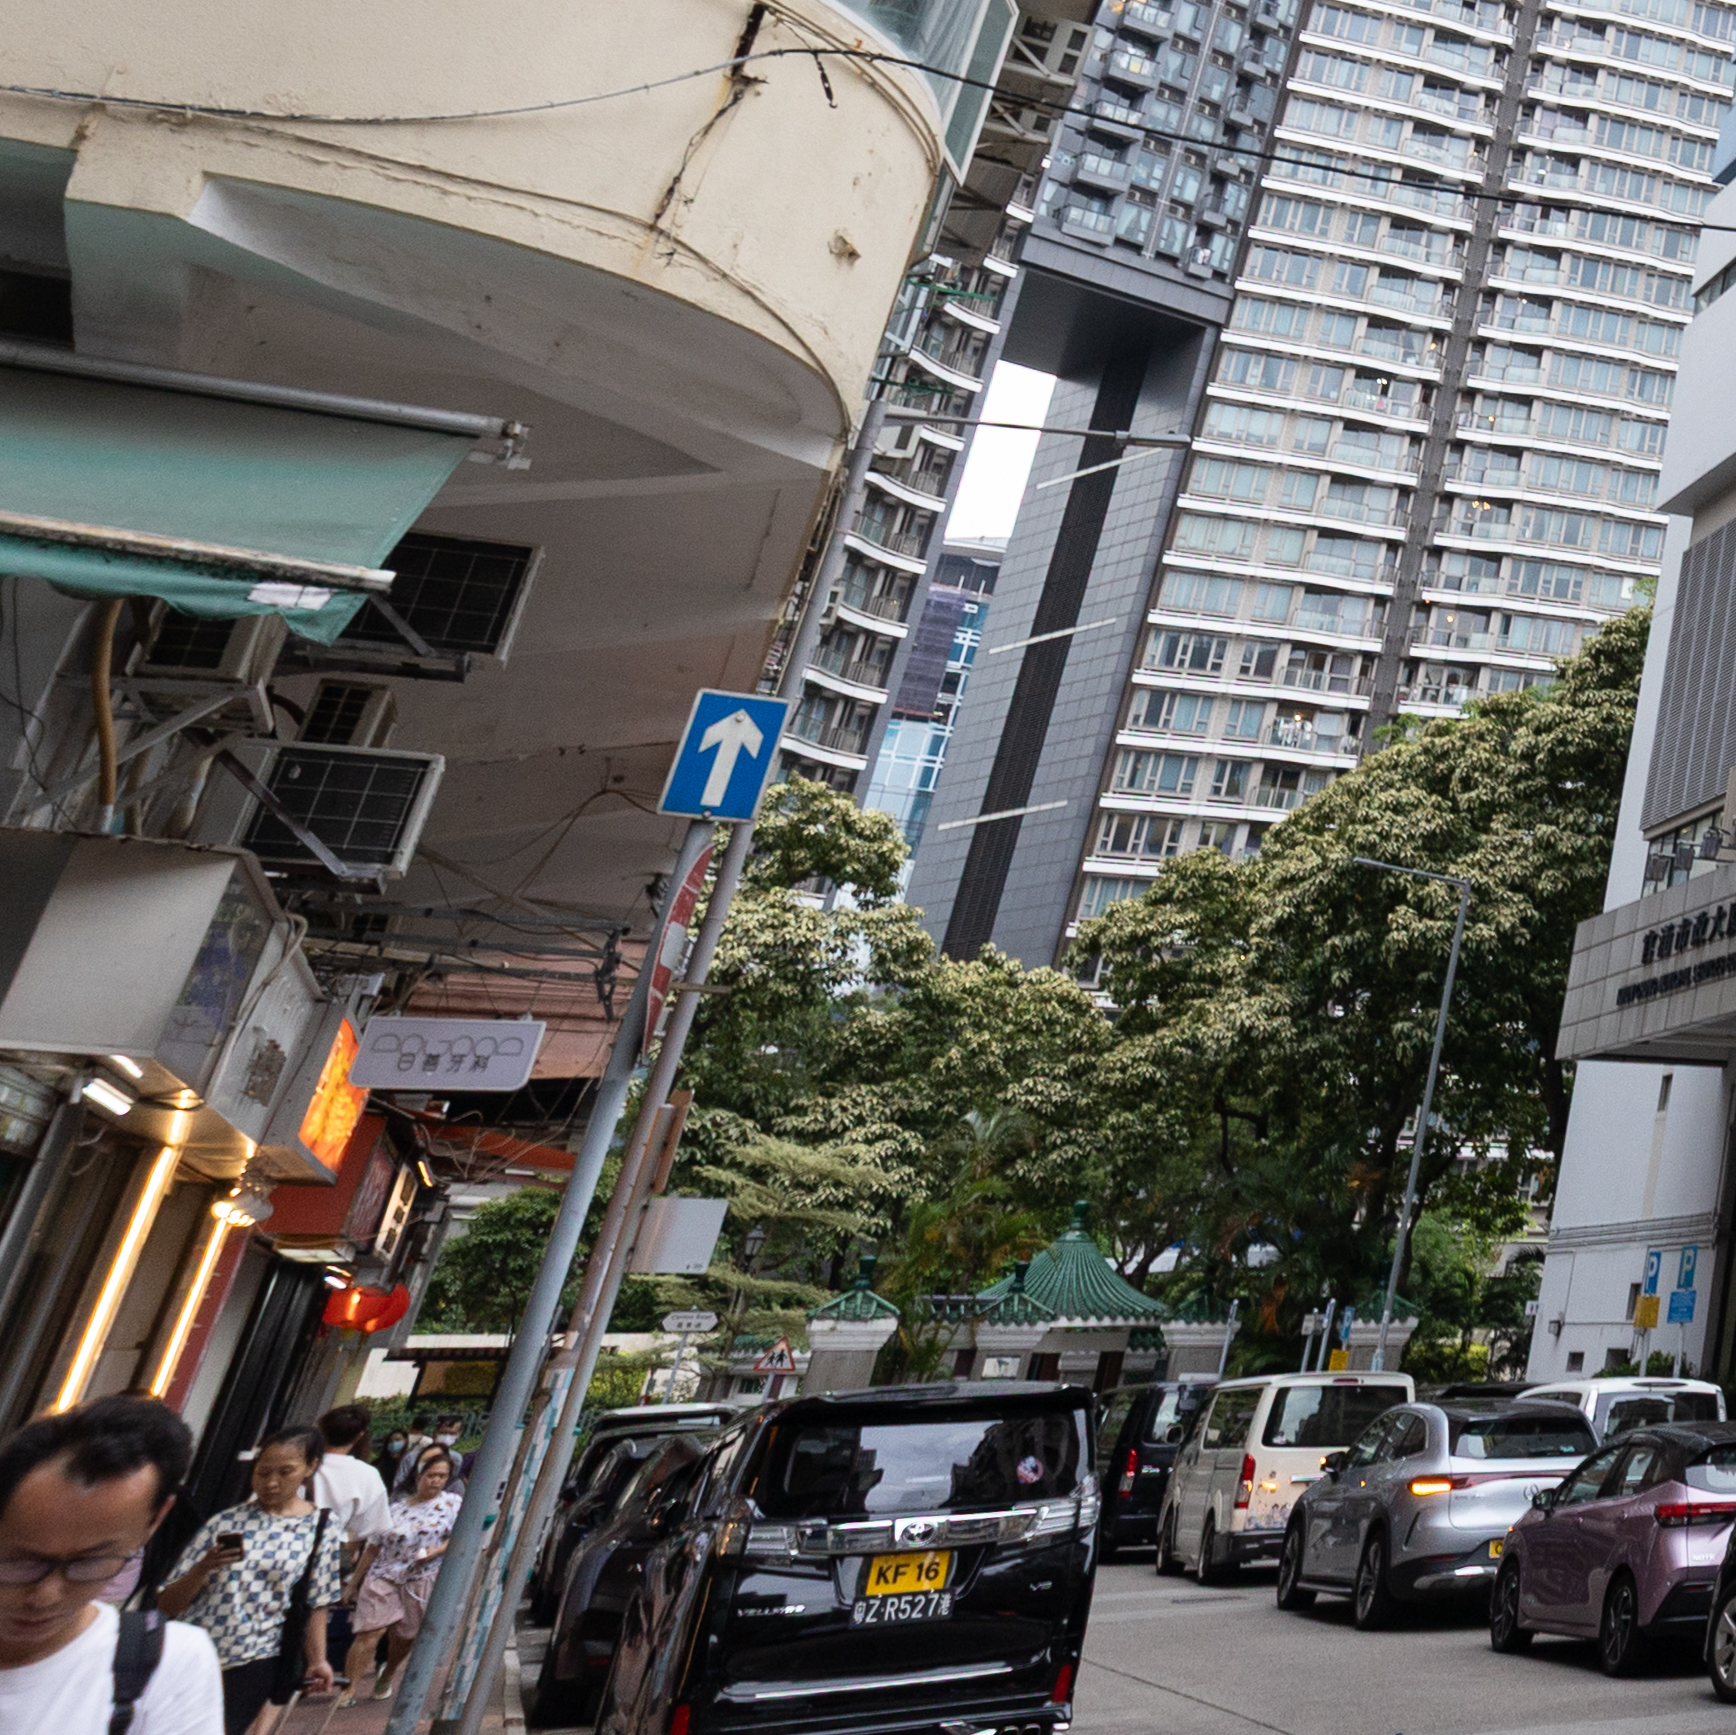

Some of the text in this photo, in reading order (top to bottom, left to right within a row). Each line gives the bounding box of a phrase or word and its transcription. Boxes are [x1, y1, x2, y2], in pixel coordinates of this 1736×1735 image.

[1646, 1255, 1658, 1291] P
[1681, 1248, 1695, 1286] P
[875, 1561, 941, 1586] KF 16
